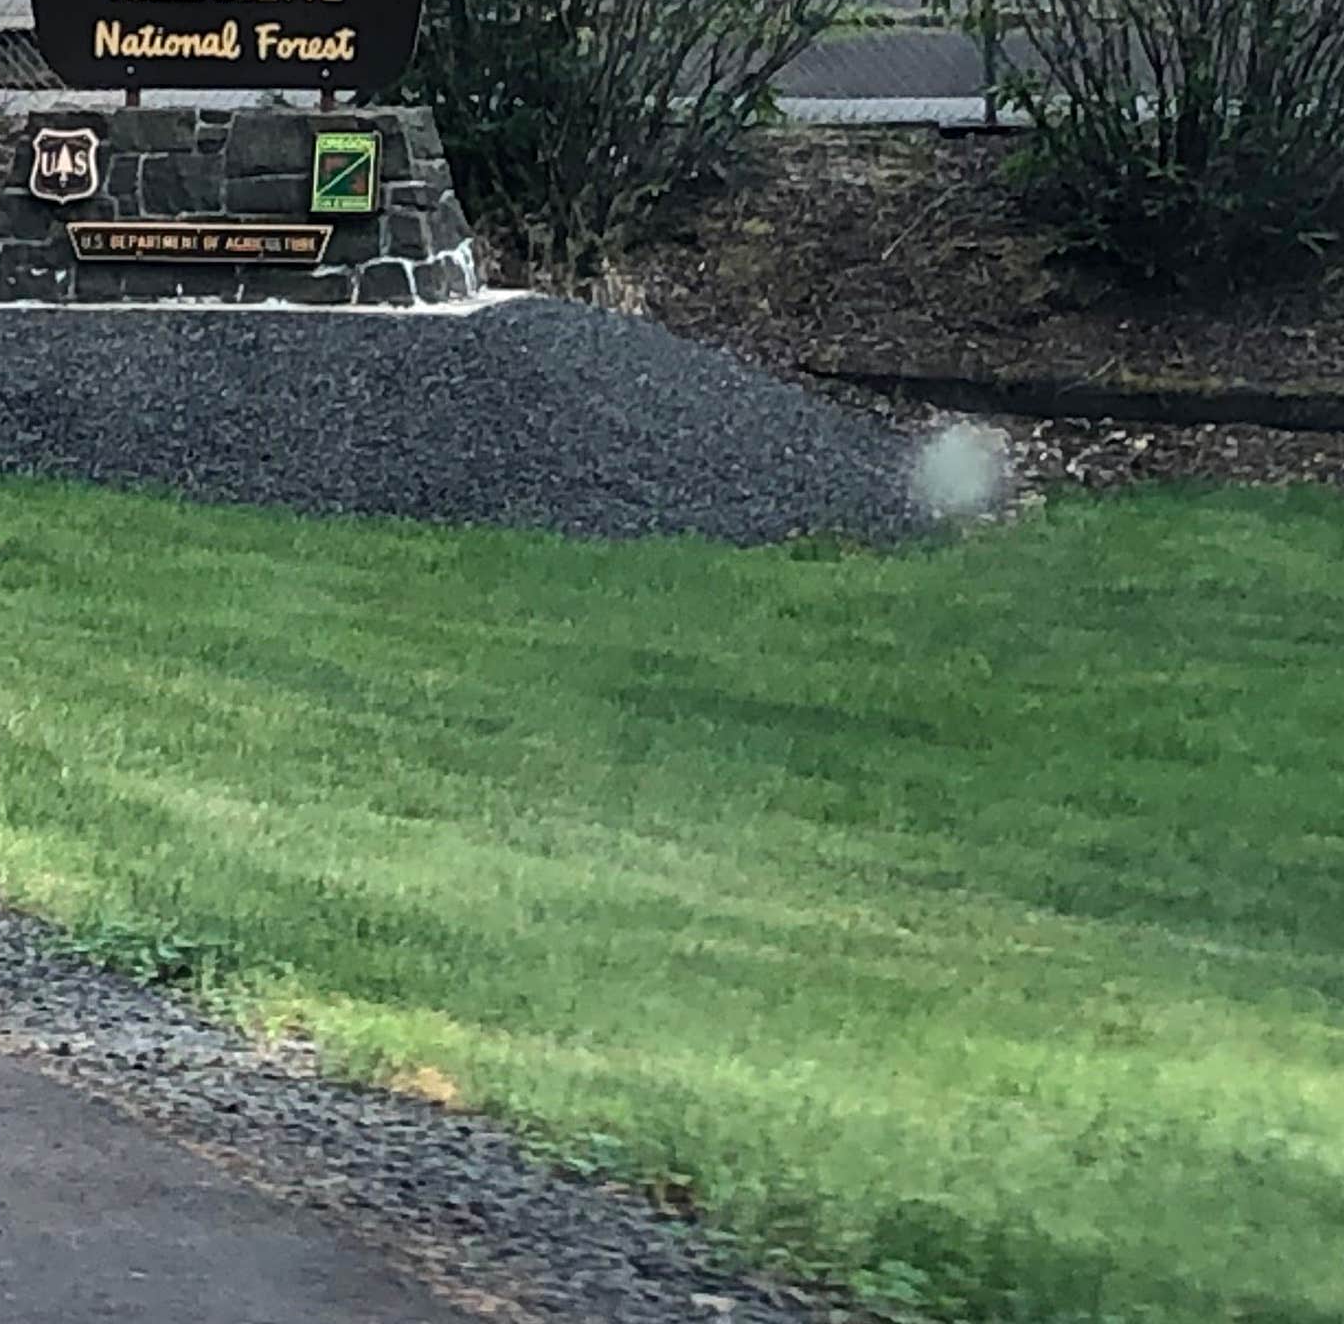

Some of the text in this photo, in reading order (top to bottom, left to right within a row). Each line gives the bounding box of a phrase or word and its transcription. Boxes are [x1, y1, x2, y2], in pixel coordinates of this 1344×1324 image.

[94, 19, 356, 61] National Forest
[203, 234, 220, 251] OF
